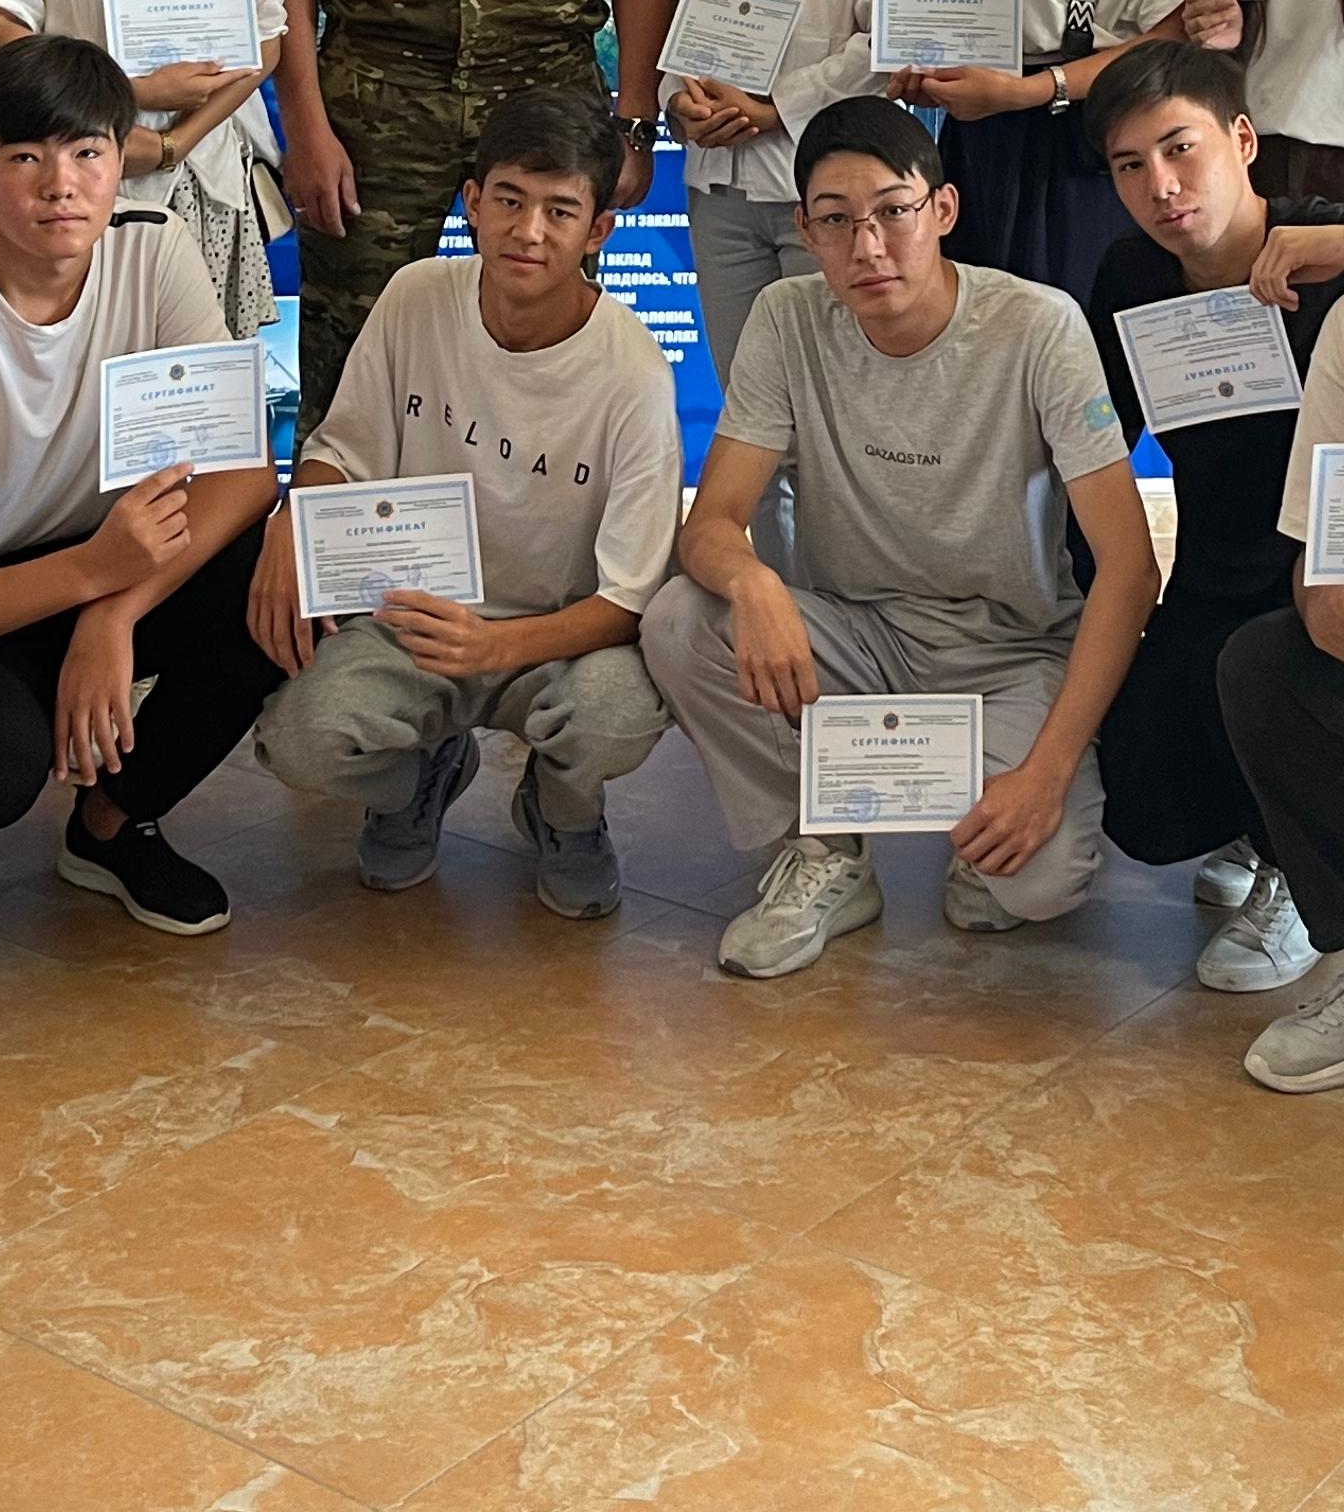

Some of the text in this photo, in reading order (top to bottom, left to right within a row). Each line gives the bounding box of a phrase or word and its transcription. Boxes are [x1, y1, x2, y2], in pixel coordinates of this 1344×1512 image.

[147, 3, 215, 13] СЕРТИФИКАТ
[712, 14, 766, 32] СЕРТИФИКАТ
[606, 253, 652, 268] вклад
[672, 272, 698, 285] что
[1184, 363, 1256, 381] СЕРТИФИКАТ
[140, 383, 216, 401] СЕРТИФИКАТ
[406, 394, 591, 486] RELOAD
[864, 444, 941, 465] QAZAQSTAN
[346, 522, 427, 537] СЕРТИФИКАТ
[851, 737, 931, 747] СЕРТИФИКАТ
